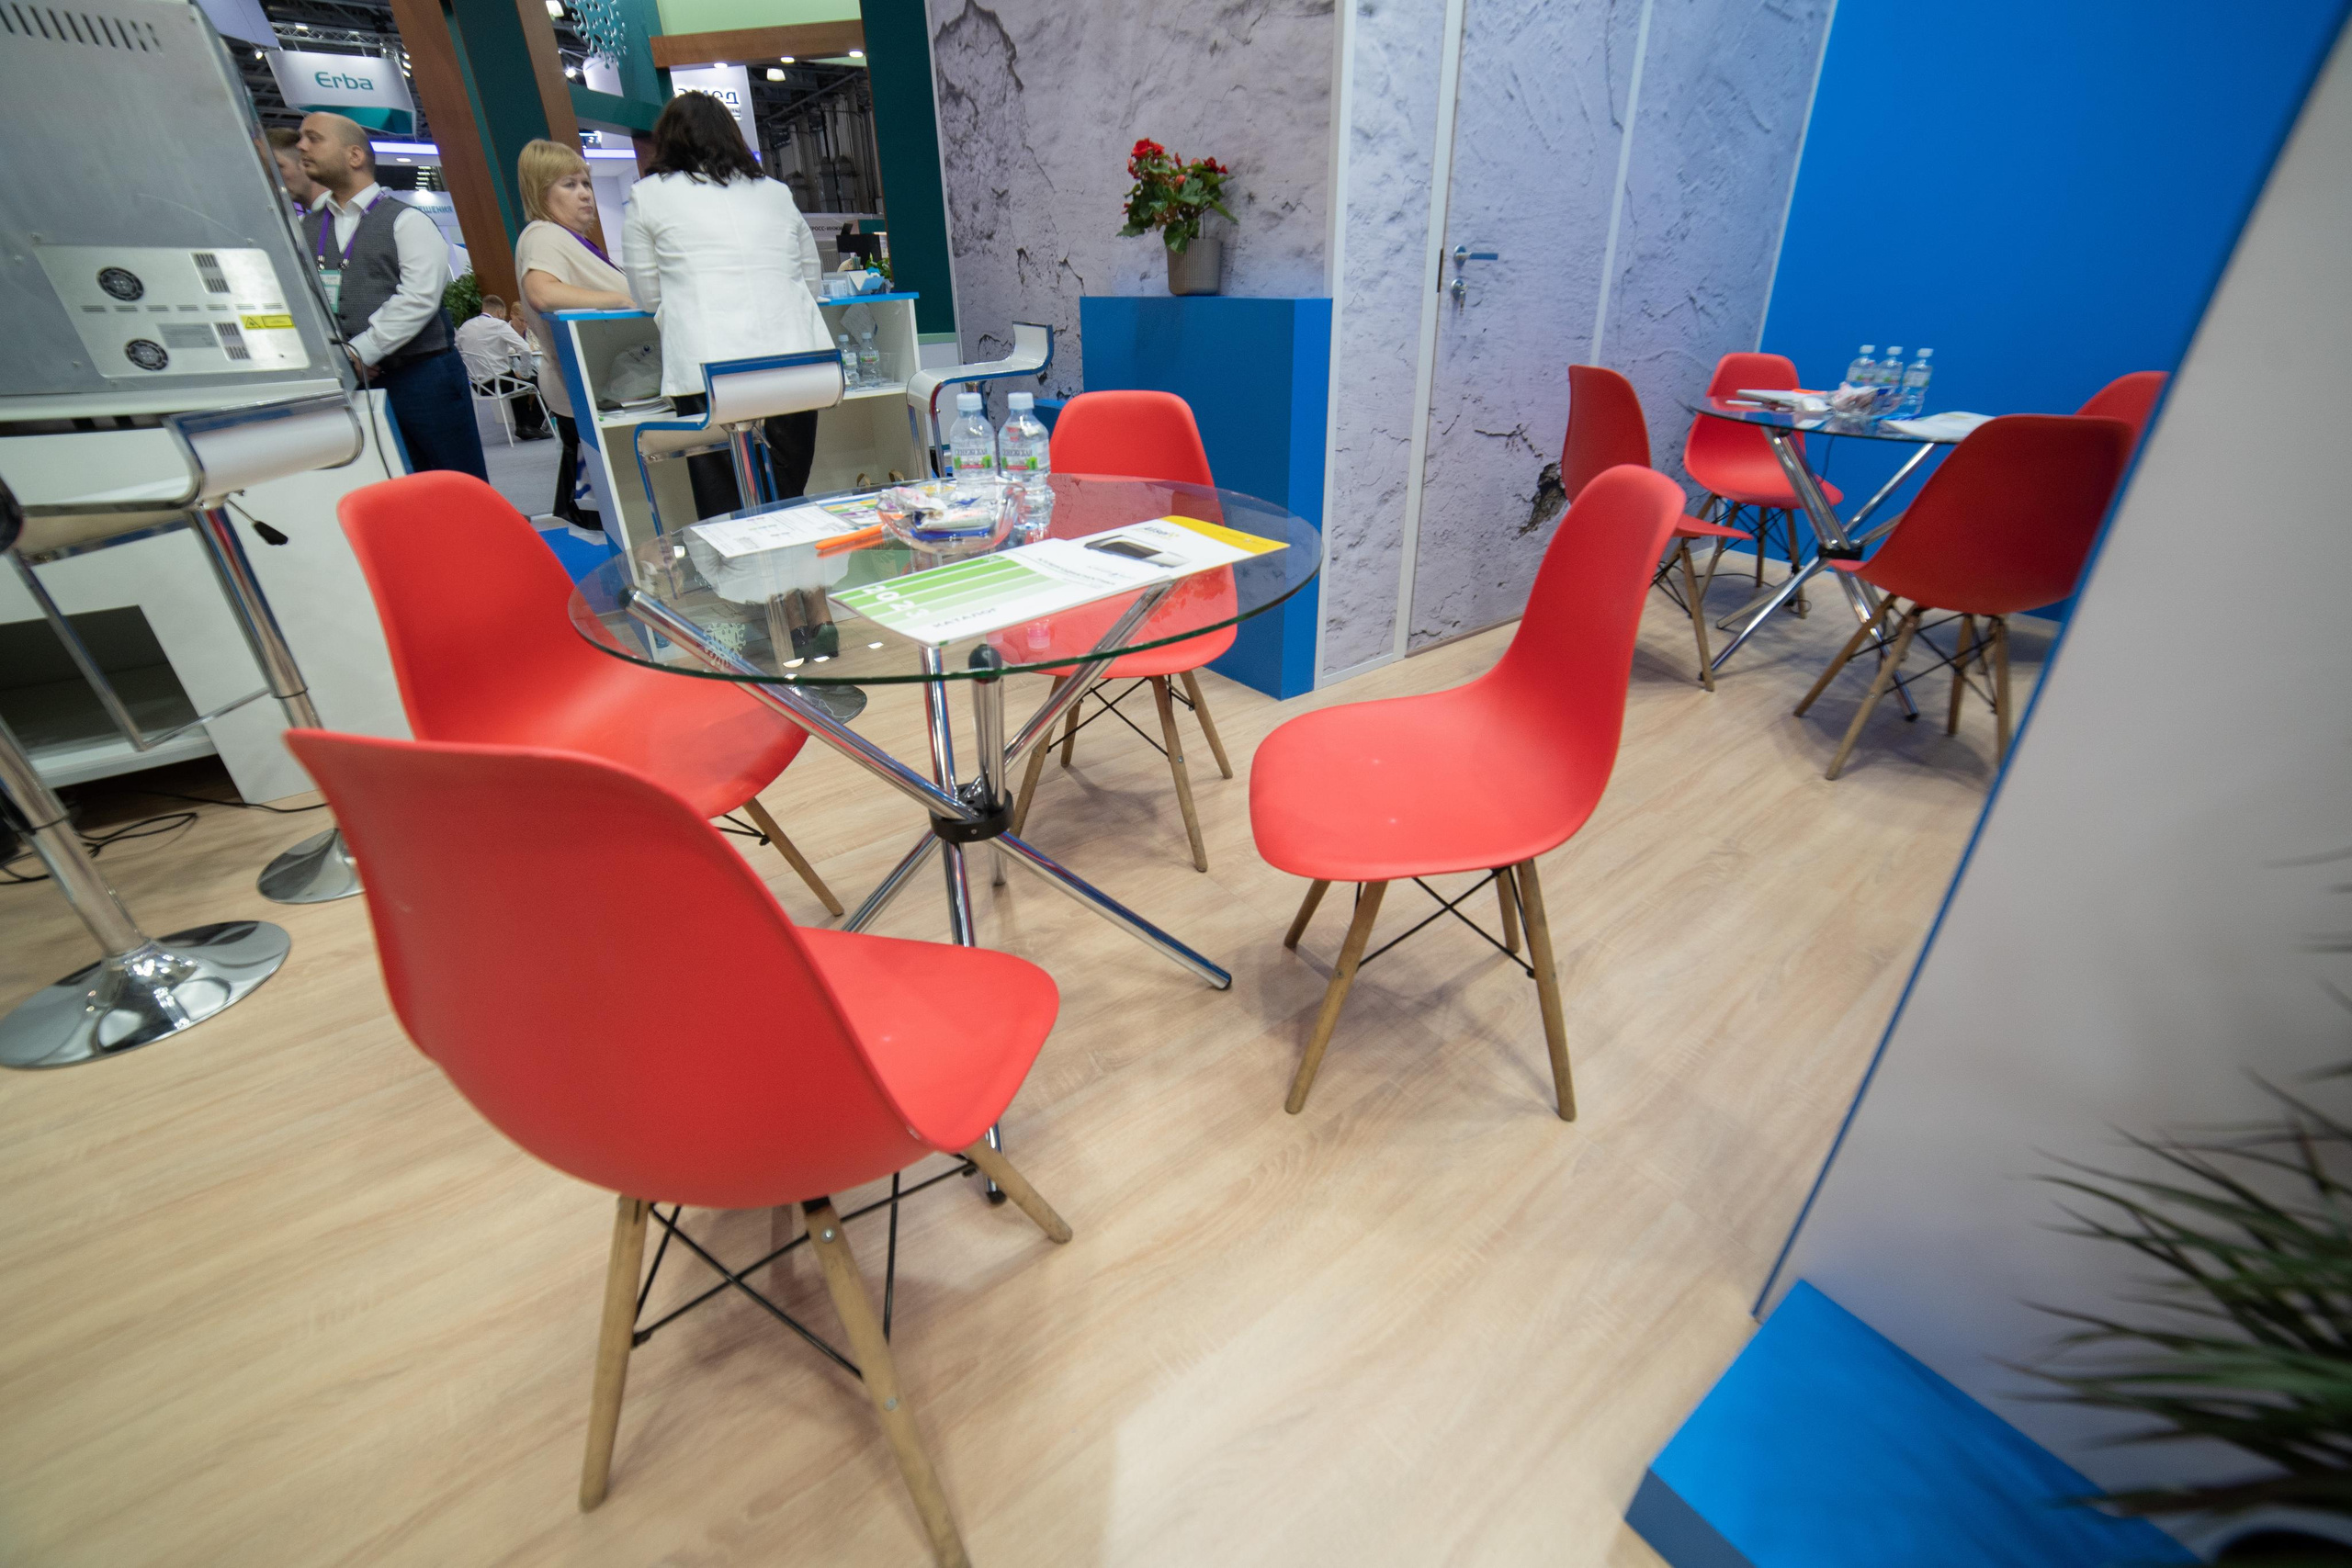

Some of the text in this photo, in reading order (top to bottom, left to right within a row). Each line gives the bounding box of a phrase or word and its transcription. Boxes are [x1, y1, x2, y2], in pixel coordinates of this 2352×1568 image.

[314, 71, 374, 90] Erba
[414, 205, 453, 213] ЕШЕНИЯ
[862, 585, 930, 617] 2023
[933, 607, 997, 628] КАТАЛОГ
